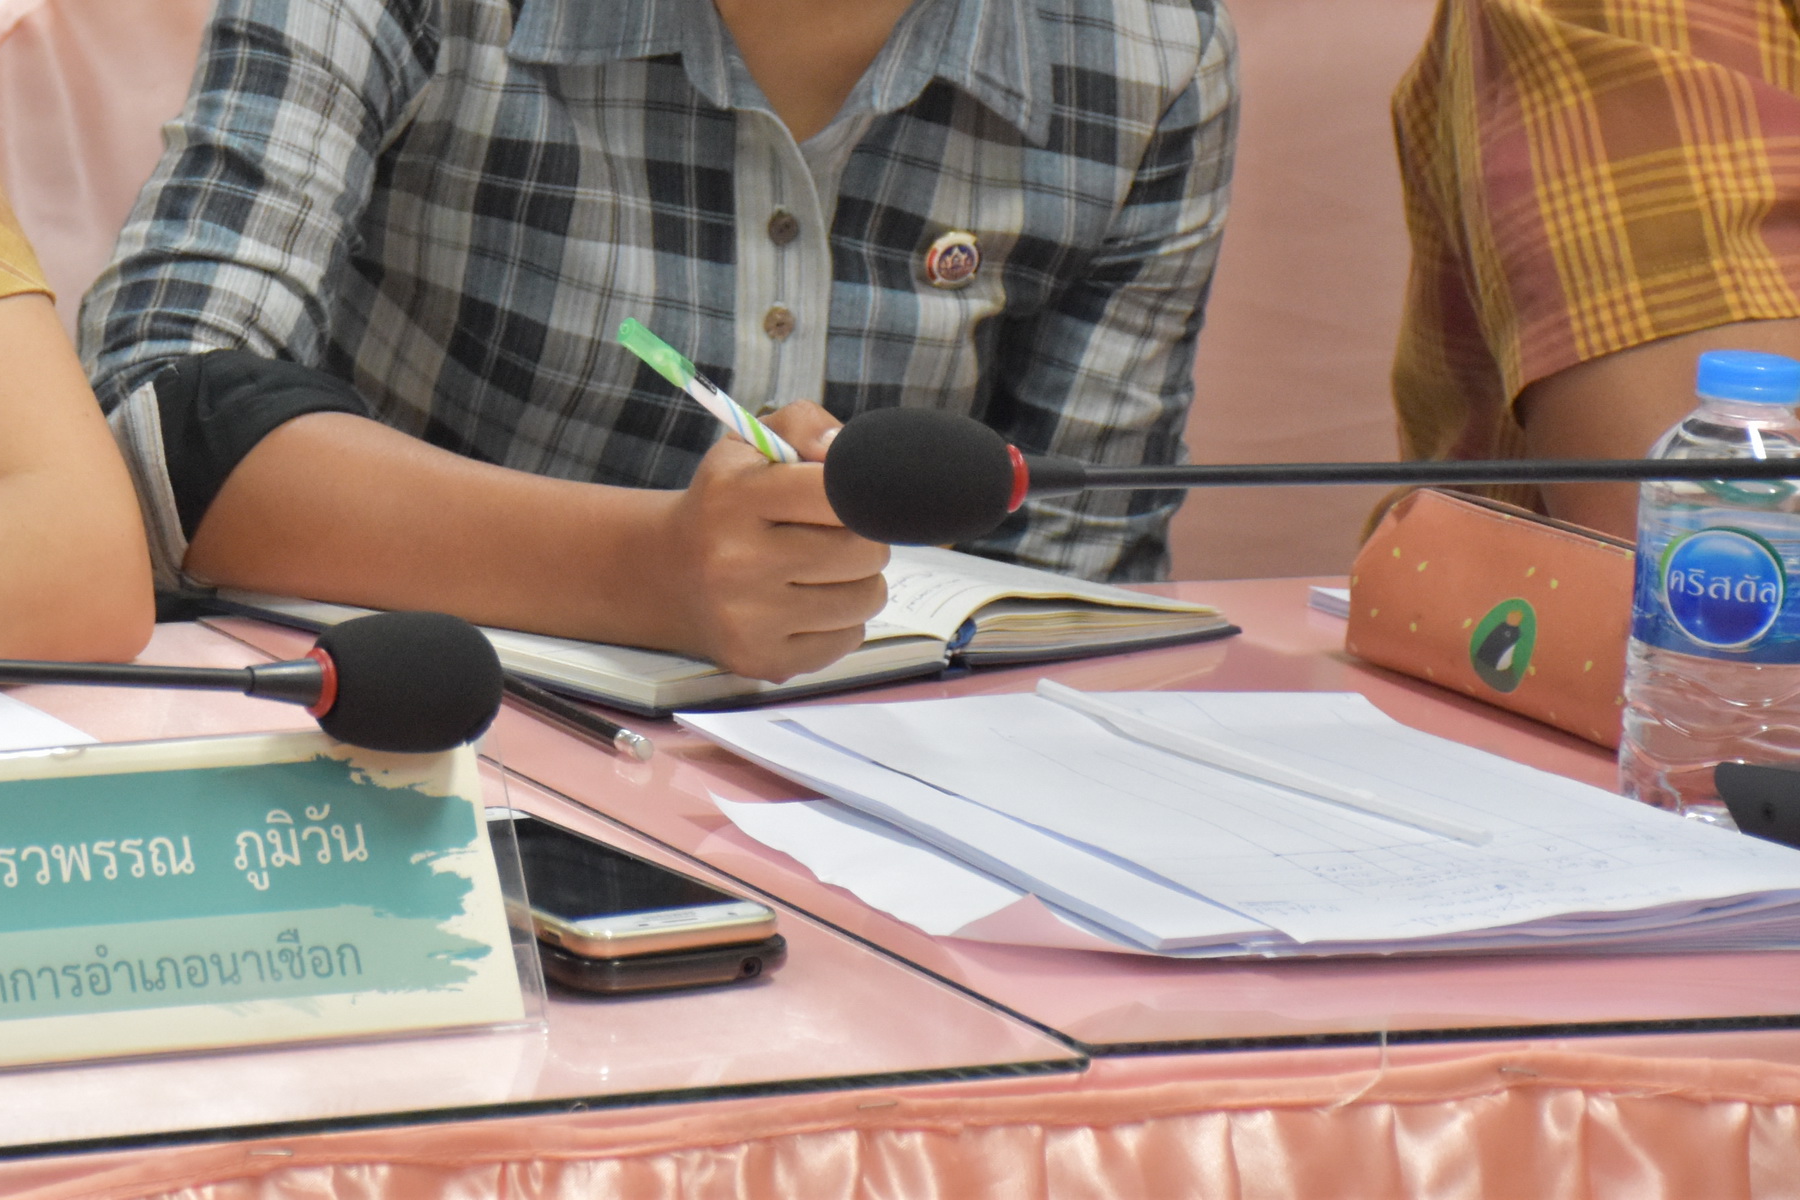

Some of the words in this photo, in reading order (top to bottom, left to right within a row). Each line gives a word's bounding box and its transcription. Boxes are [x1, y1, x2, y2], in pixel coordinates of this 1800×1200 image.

[1670, 568, 1777, 603] คริสตัล
[234, 803, 369, 891] ภูมิวัน
